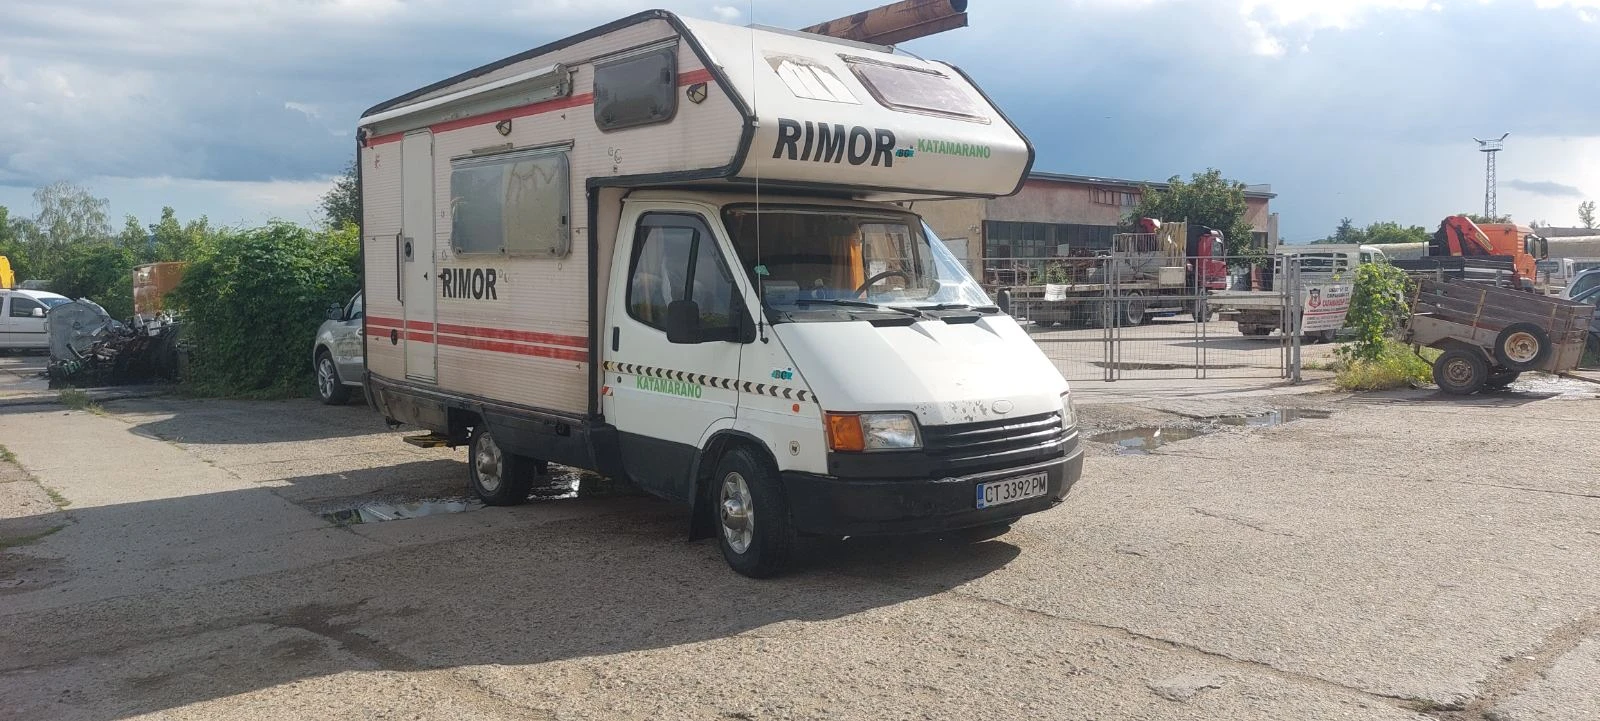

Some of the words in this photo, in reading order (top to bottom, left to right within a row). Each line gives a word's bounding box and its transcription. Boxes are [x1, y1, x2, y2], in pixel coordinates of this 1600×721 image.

[772, 117, 896, 168] RIMOR
[917, 138, 991, 159] KATAMARANO
[442, 268, 498, 300] RIMOR
[636, 375, 702, 399] KATAMARANO
[985, 485, 1001, 503] CT
[1003, 480, 1031, 500] 3392
[1032, 476, 1046, 493] PM
